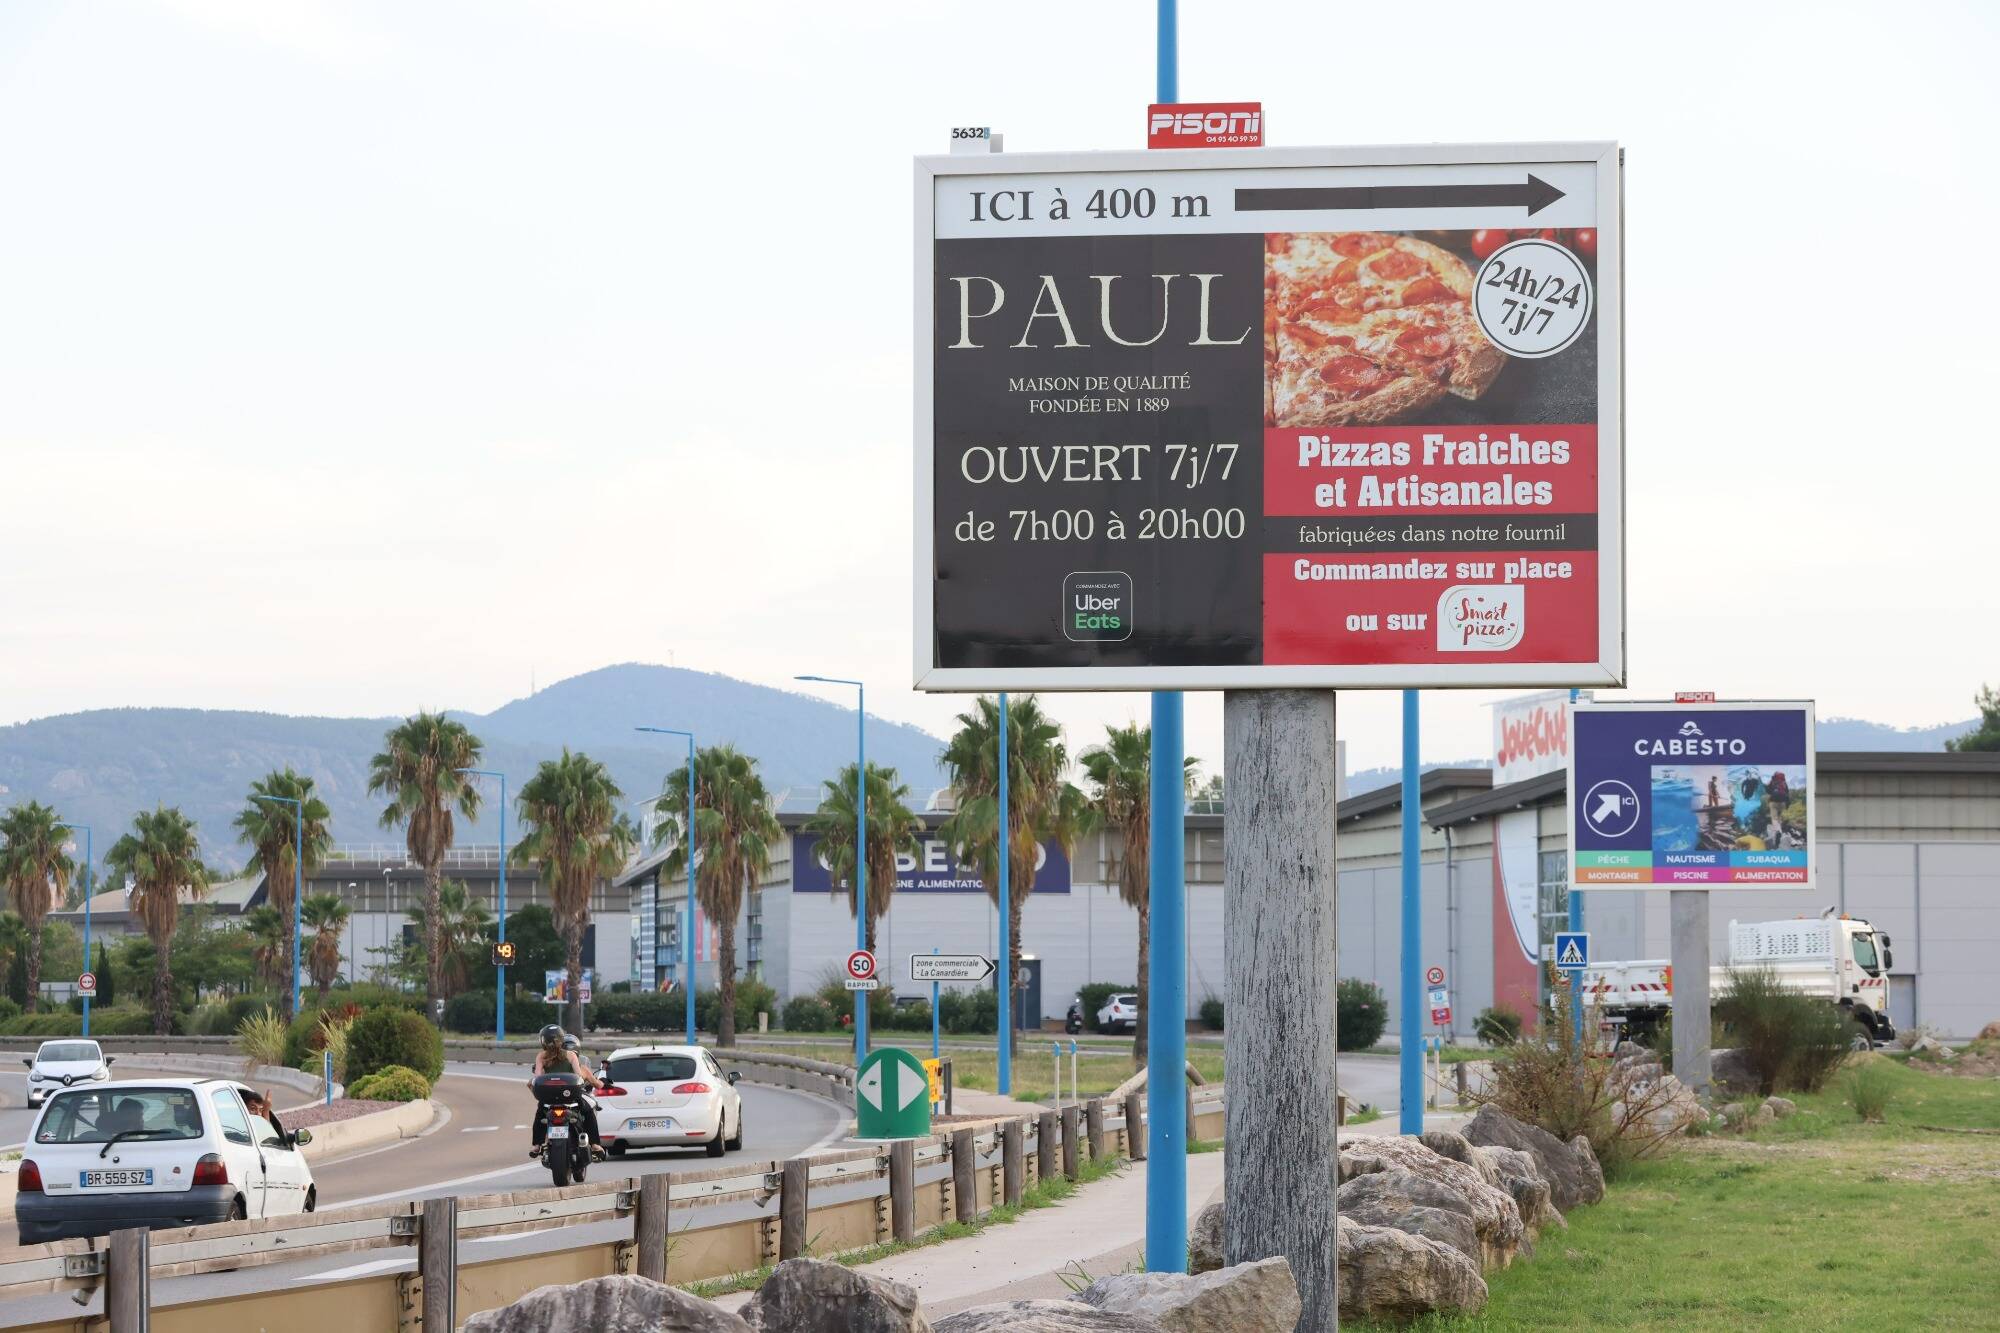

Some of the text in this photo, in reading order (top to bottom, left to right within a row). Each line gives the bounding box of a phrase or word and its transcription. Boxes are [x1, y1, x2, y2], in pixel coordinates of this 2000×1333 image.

[969, 187, 1211, 222] ICI à 400 m
[1485, 260, 1582, 310] 24h/24
[948, 273, 1252, 349] PAUL
[1501, 298, 1555, 336] 7j/7
[1008, 371, 1191, 393] MAISON DE QUALITÉ
[1029, 394, 1170, 413] FONDÉE EN 1889
[1298, 433, 1570, 467] Pizzas Fraiches
[961, 443, 1239, 489] OUVERT 7j/7
[1315, 474, 1553, 507] et Artisanales
[955, 508, 1246, 542] de 7h00 à 20h00
[1299, 523, 1566, 546] fabriquées dans notre fournil
[1294, 557, 1573, 584] Commandez sur place
[1075, 594, 1121, 611] Uber
[1456, 597, 1508, 621] Smart
[1075, 613, 1121, 629] Eats
[1346, 613, 1428, 631] ou sur
[1463, 621, 1505, 645] pizza
[1634, 739, 1747, 756] CABESTO
[1622, 797, 1635, 805] ICI
[1597, 853, 1630, 864] PÊCHE
[1666, 854, 1716, 864] NAUTISME
[1746, 855, 1791, 864] SUBAQUA
[1588, 871, 1639, 880] MONTAGNE
[1673, 871, 1709, 879] PISCINE
[1735, 871, 1804, 880] ALIMENTATION
[497, 945, 512, 958] 49
[853, 960, 870, 971] 50
[934, 959, 979, 967] commerciale
[920, 969, 929, 977] La
[930, 968, 969, 977] Canardière
